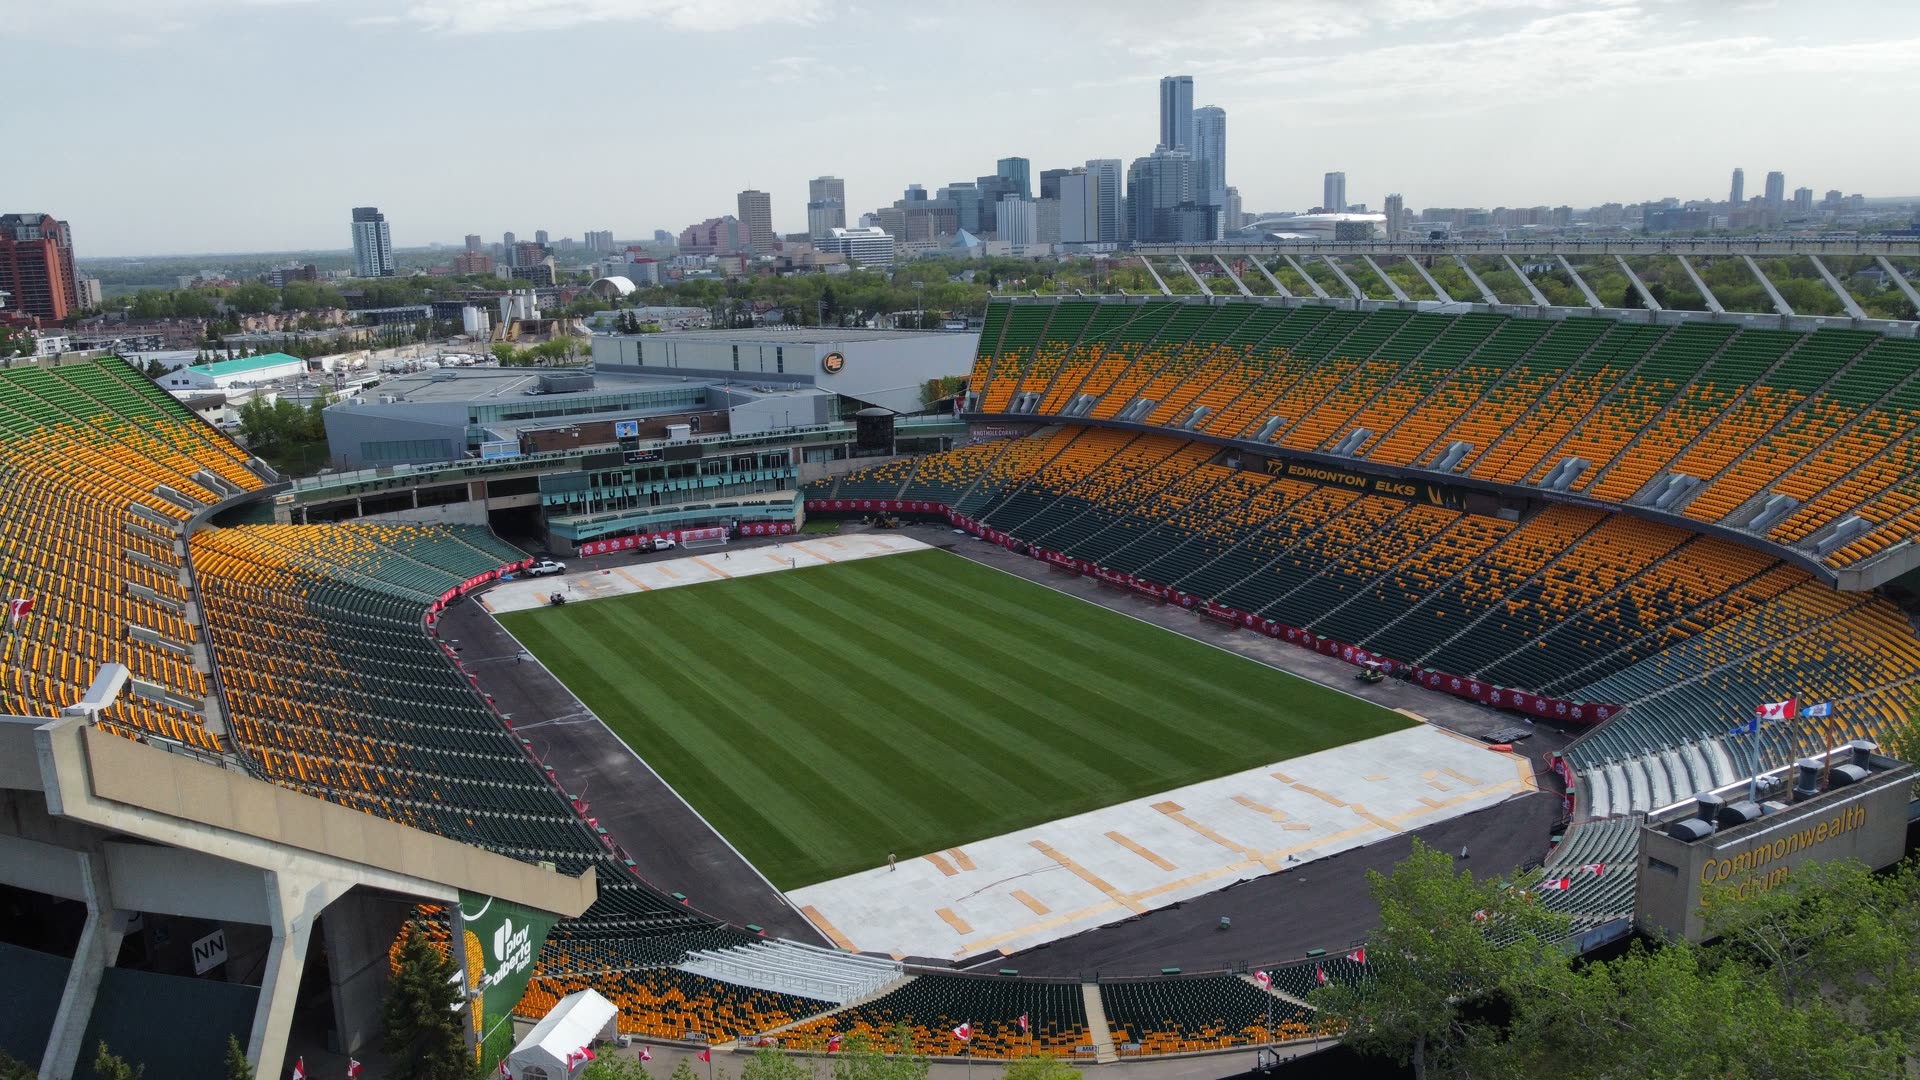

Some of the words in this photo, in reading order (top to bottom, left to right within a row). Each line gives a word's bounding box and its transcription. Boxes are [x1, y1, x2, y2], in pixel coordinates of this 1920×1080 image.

[550, 477, 703, 505] COMMONWEALTH
[718, 465, 792, 485] STADIUM
[1288, 465, 1367, 487] EDMONTON
[1375, 480, 1416, 496] ELKS
[1702, 803, 1866, 885] Commonwealth
[194, 935, 224, 963] NN
[506, 924, 529, 960] play
[493, 940, 531, 986] alberta
[516, 953, 531, 974] field
